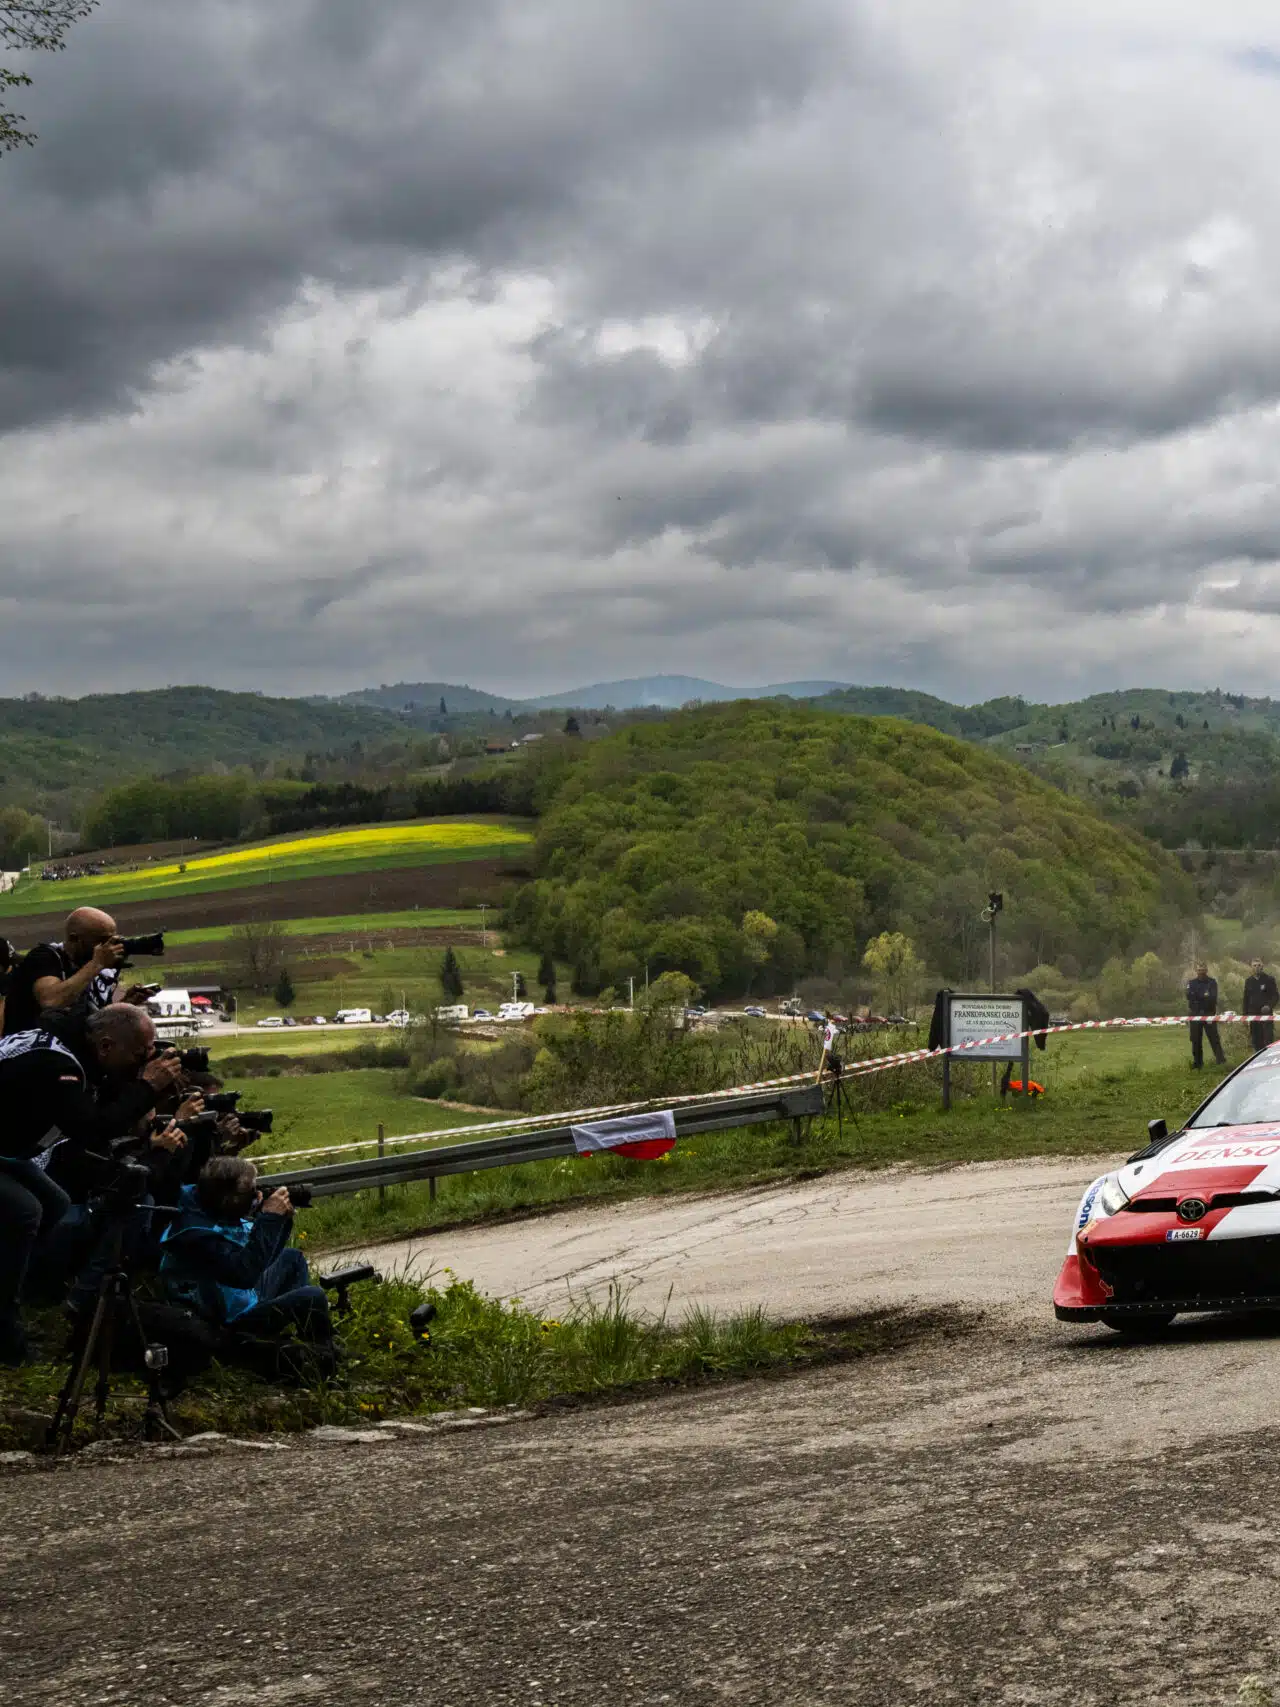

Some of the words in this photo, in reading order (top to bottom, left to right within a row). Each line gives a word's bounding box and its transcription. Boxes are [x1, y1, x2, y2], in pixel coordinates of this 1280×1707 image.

[954, 1010, 1001, 1018] FRANKOPANSKI
[1002, 1010, 1020, 1019] GRAD
[1173, 1229, 1199, 1240] A-6629
